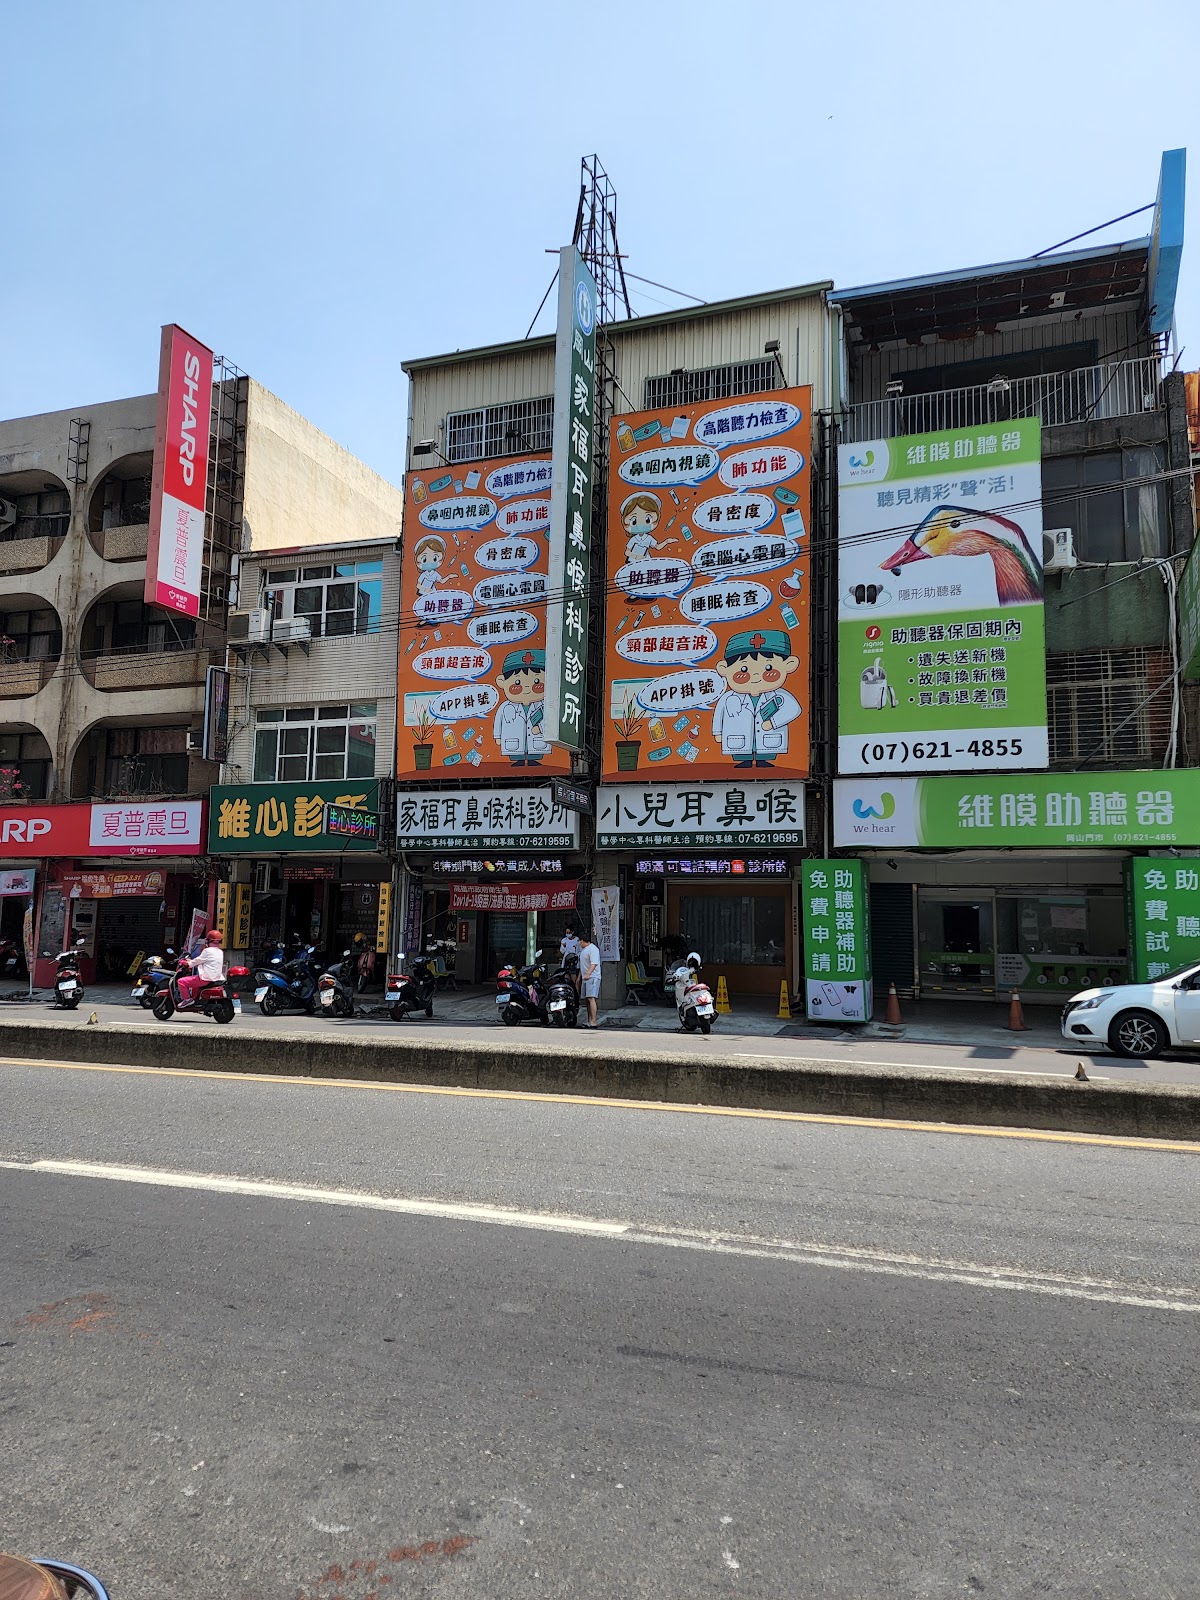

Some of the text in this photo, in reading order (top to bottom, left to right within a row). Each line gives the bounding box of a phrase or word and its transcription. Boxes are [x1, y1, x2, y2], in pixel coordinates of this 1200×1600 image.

[179, 349, 200, 488] SHARP
[703, 408, 789, 436] 高階聽力檢查
[907, 431, 1021, 465] 維膜助聽器
[629, 453, 711, 476] 鼻咽內視鏡
[732, 455, 787, 478] 肺功能
[427, 503, 491, 521] 鼻咽內視鏡
[506, 506, 548, 525] 肺功能
[708, 503, 761, 522] 骨密度
[561, 328, 593, 733] 岡山 家福耳鼻喉科診所
[175, 507, 190, 585] 夏普震旦
[486, 546, 527, 561] 骨密度
[700, 543, 786, 567] 電腦心電圖
[629, 567, 680, 586] 助聽器
[479, 580, 546, 599] 電腦心電圖
[898, 584, 962, 600] 隱形助聽器
[424, 598, 464, 613] 助聽器
[691, 590, 759, 612] 睡眠檢查
[476, 618, 528, 636] 睡眠檢查
[891, 619, 1022, 644] 助聽器保固期內
[627, 635, 708, 653] 頸部超音波
[421, 655, 485, 670] 頸部超音波
[918, 648, 1006, 667] 遺失送新機
[918, 668, 1007, 687] 故障換新機
[918, 688, 1008, 706] 買貴退差價
[861, 739, 1023, 764] (07)621-4855
[400, 796, 568, 832] 家福耳鼻喉科診所
[600, 788, 798, 827] 小兒耳鼻喉
[958, 790, 1175, 828] 維膜助聽器
[0, 818, 52, 843] RP
[102, 809, 190, 837] 夏普震旦
[853, 823, 896, 833] We hear
[400, 838, 479, 848] 醫學中心專科醫師主治
[600, 834, 690, 845] 醫學中心專科醫師主治
[1066, 833, 1177, 842] 岡山門市 (07)621-4855
[494, 860, 562, 872] 免費成人健檢
[667, 860, 731, 873] 可電話預約
[239, 888, 250, 945] 維心診所
[809, 870, 831, 973] 免費申請
[834, 870, 856, 973] 助聽器補助
